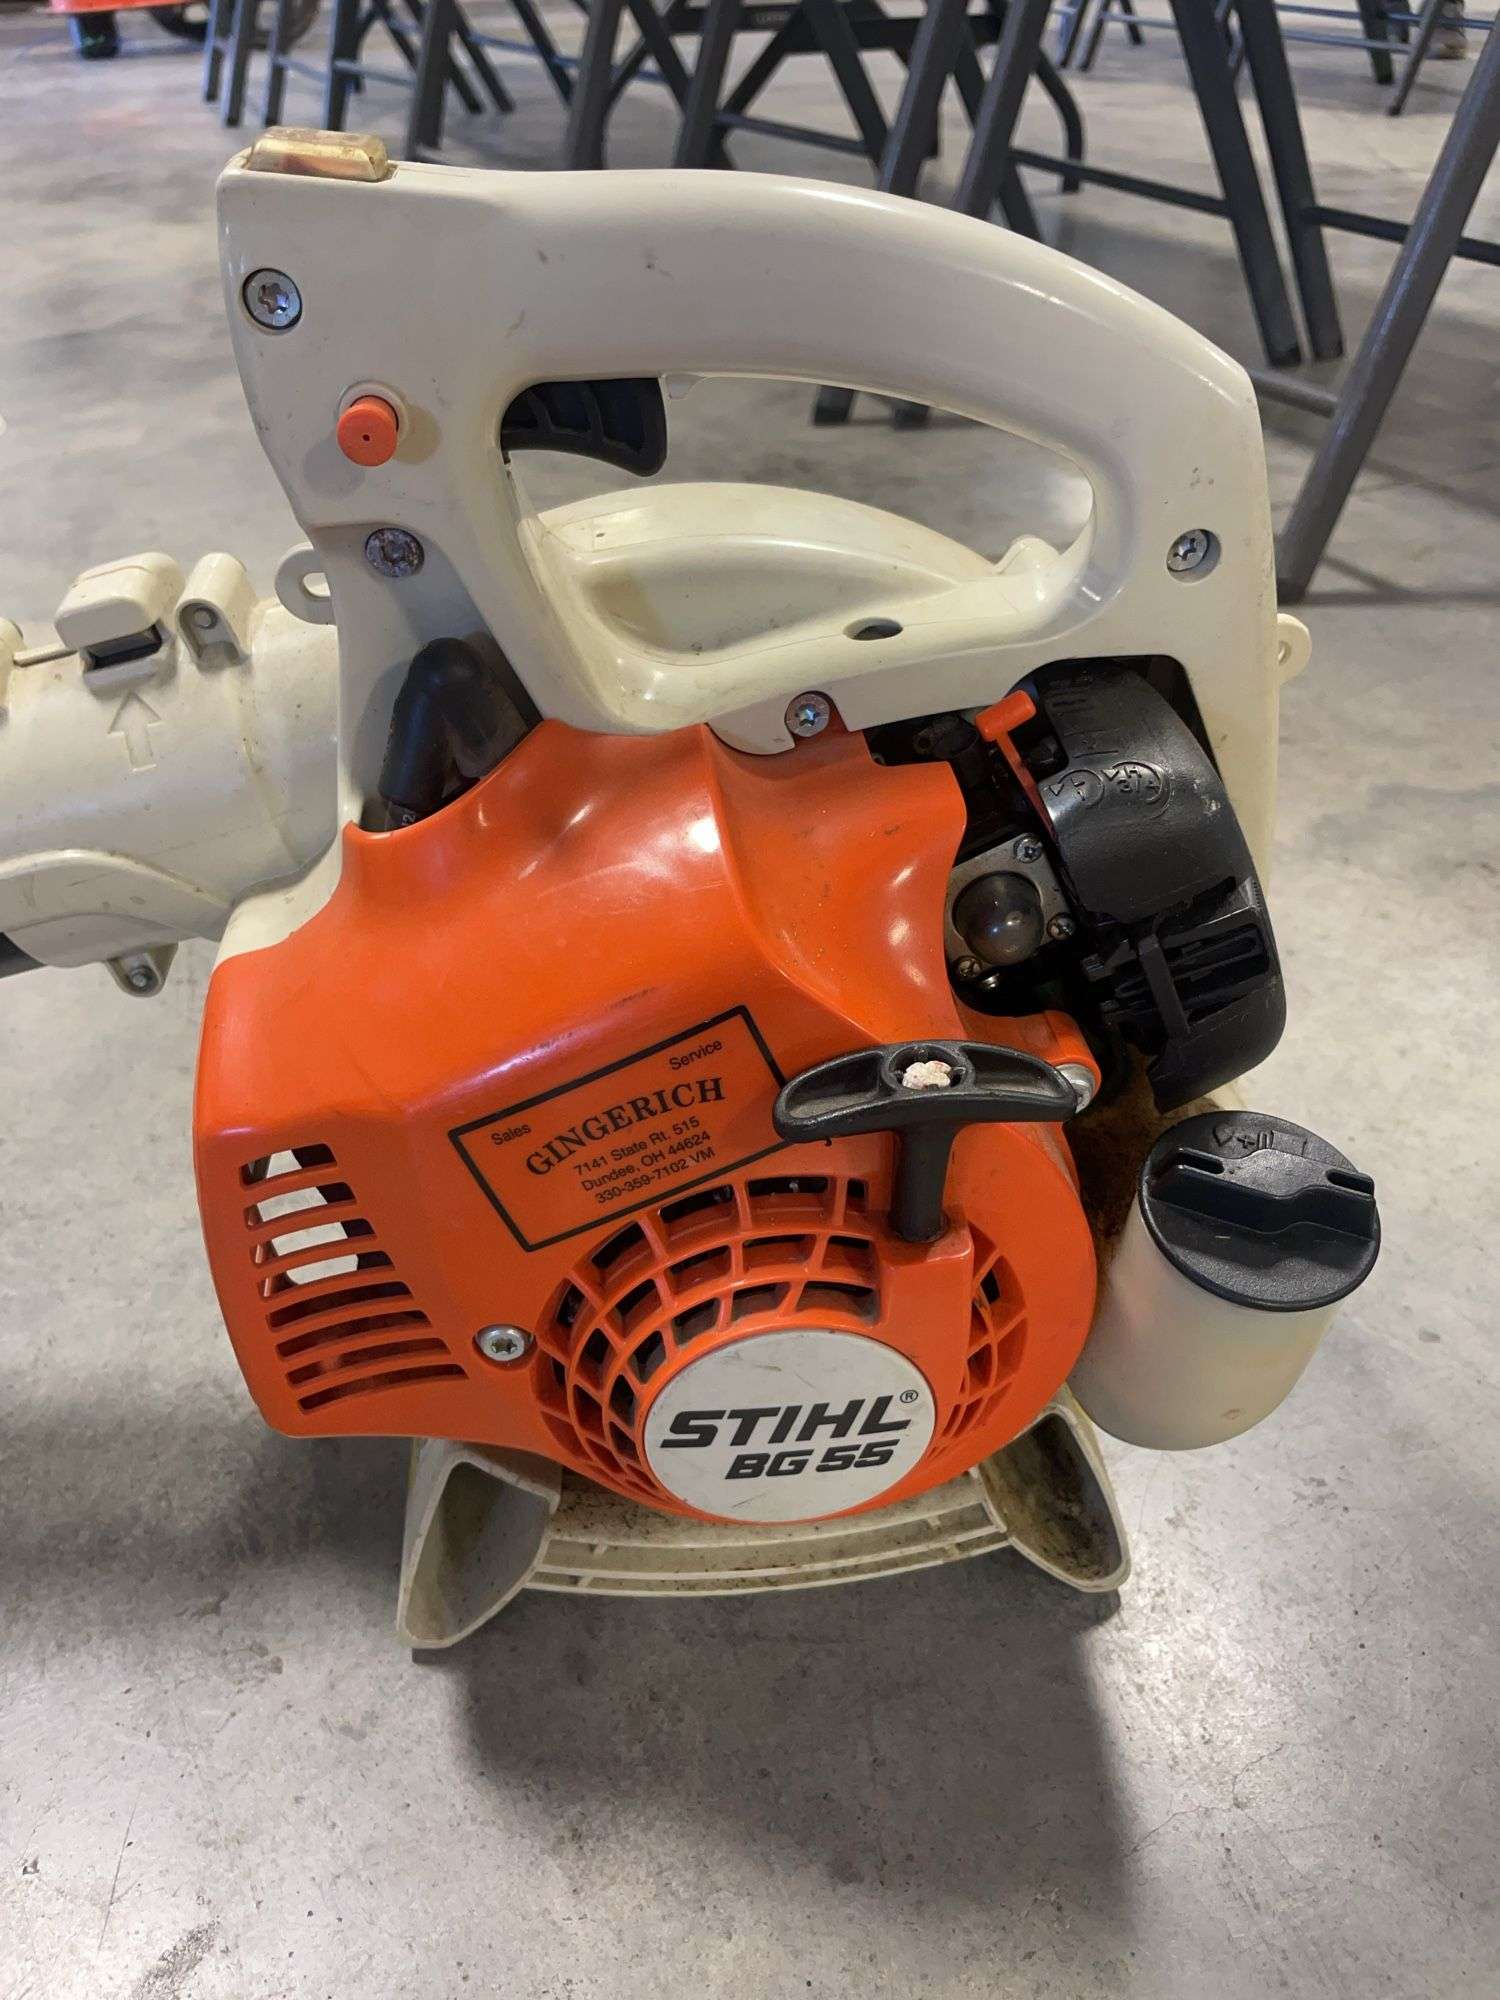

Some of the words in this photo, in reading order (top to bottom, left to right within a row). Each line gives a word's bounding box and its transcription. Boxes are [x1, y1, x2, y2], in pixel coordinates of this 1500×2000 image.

[669, 1040, 723, 1071] Service
[491, 1122, 532, 1147] Sales
[526, 1077, 726, 1176] GINGERICH
[574, 1155, 609, 1176] 7141
[610, 1140, 648, 1162] State
[649, 1131, 670, 1146] Rt.
[672, 1115, 700, 1136] 515
[581, 1163, 641, 1192] Dundee,
[640, 1150, 666, 1168] OH
[668, 1130, 711, 1156] 44624
[594, 1158, 689, 1204] 330-359-7102
[725, 1448, 815, 1480] BG
[815, 1438, 900, 1473] 55
